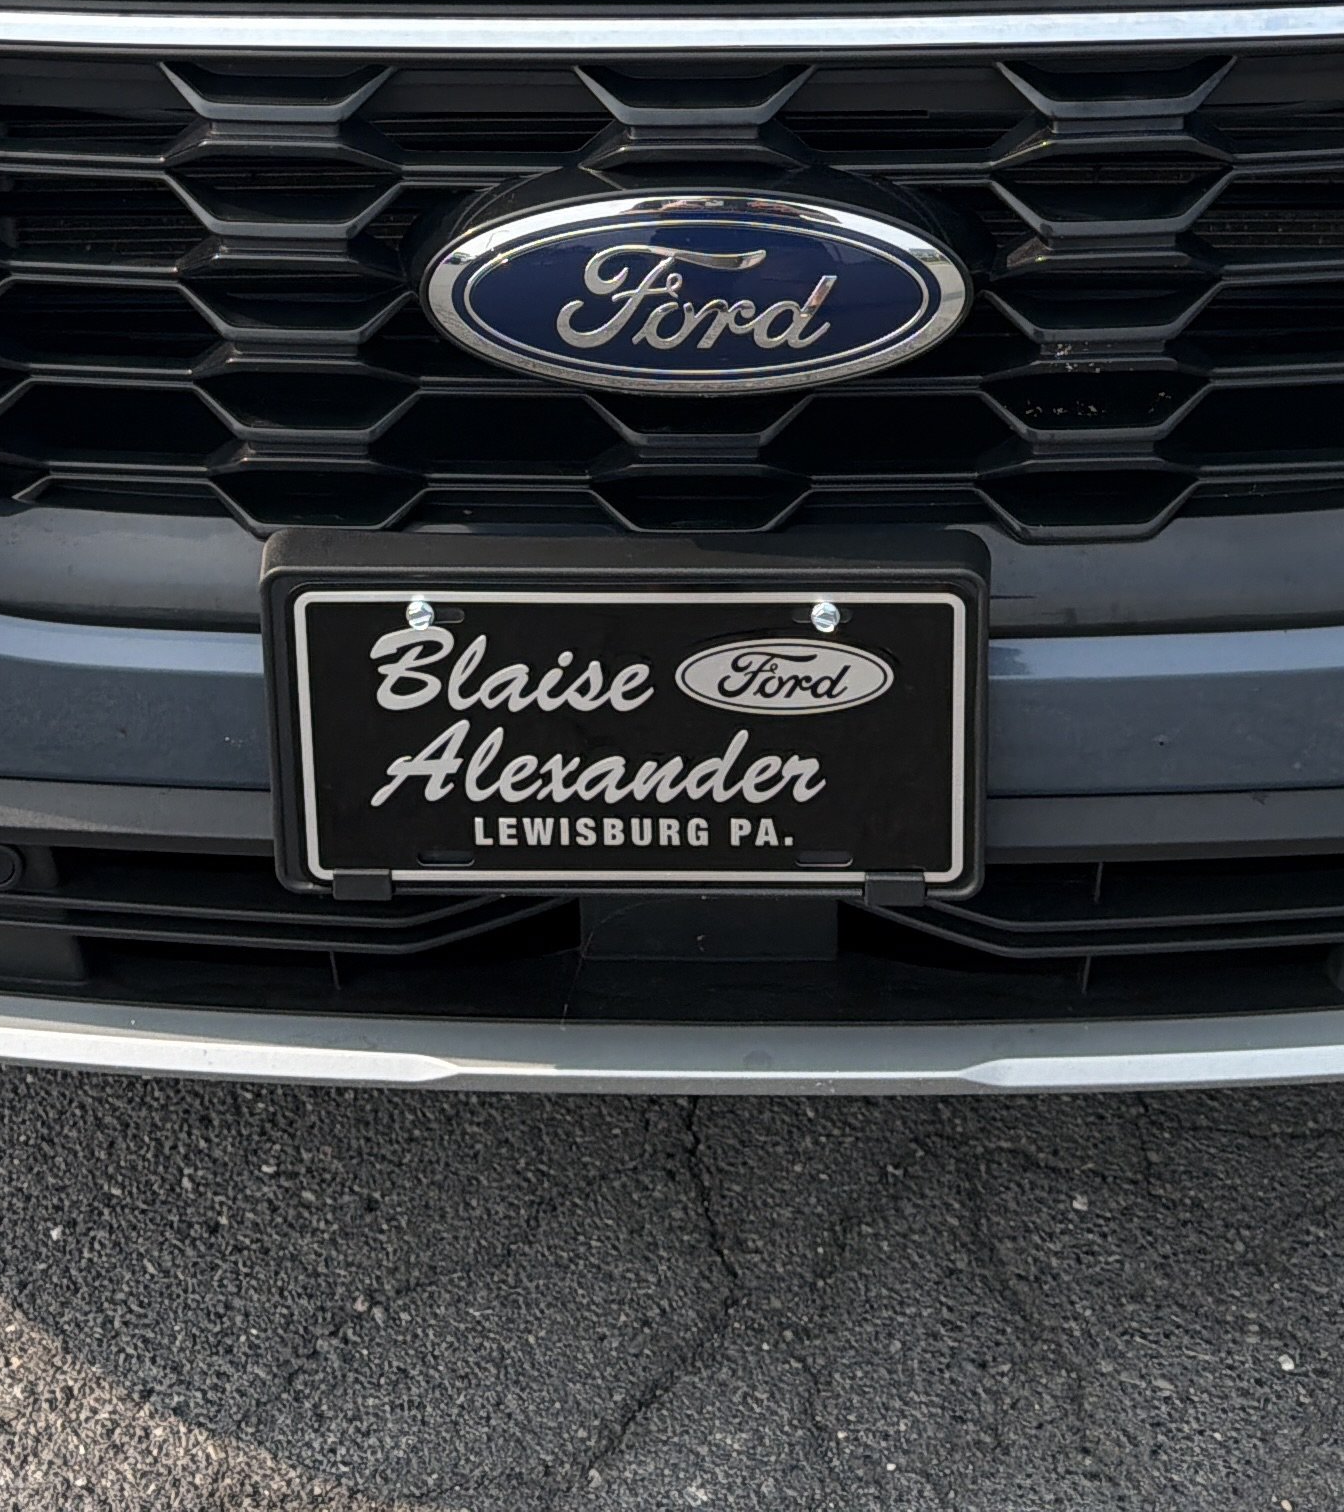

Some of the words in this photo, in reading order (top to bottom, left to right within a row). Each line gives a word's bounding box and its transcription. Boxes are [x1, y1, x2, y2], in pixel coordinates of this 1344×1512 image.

[556, 244, 837, 349] Ford
[369, 626, 654, 712] Blaise
[718, 652, 853, 700] Ford
[370, 719, 827, 807] Alexander
[474, 818, 710, 847] LEWISBURG
[729, 818, 794, 847] PA.
